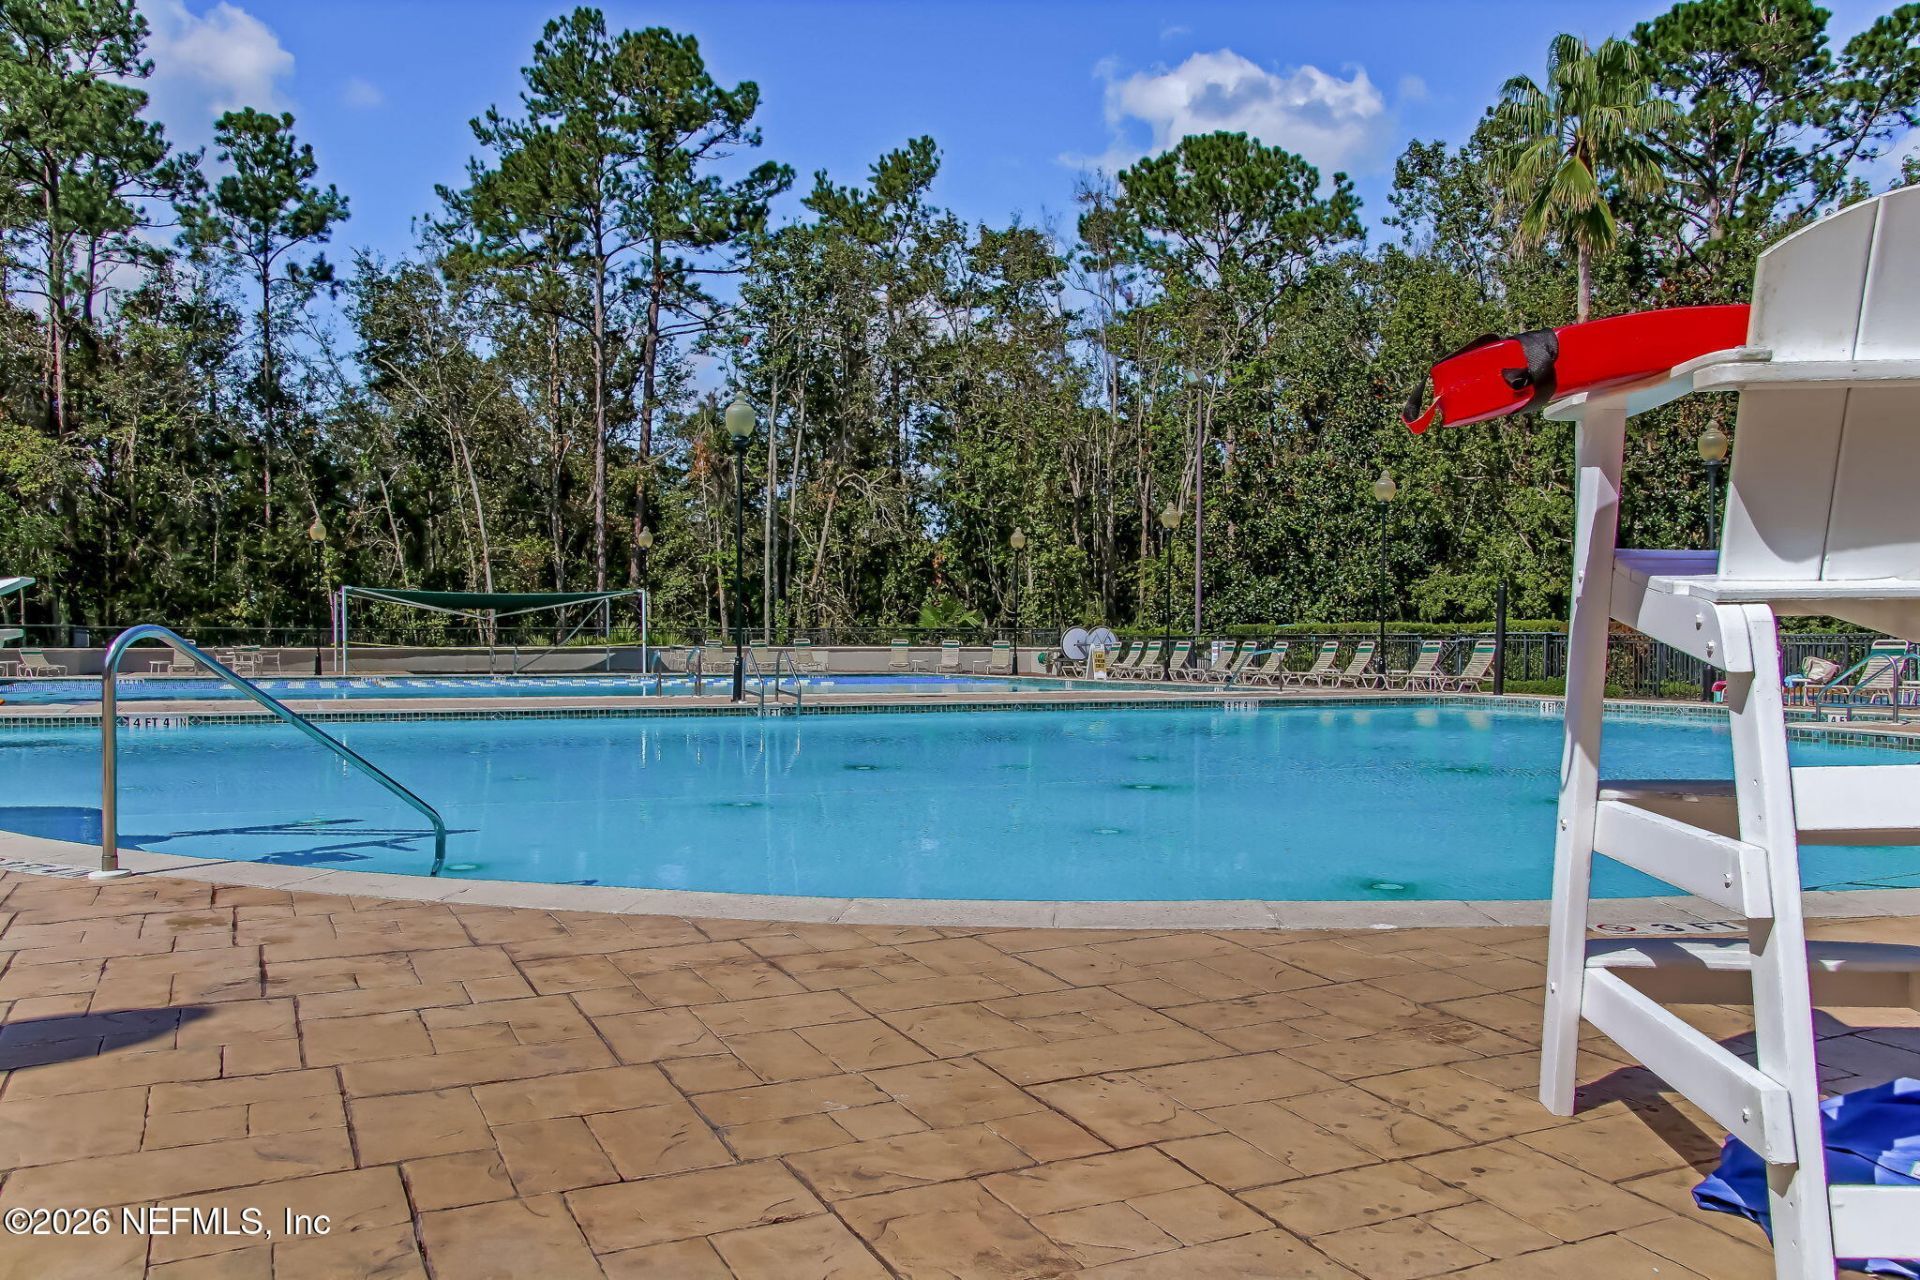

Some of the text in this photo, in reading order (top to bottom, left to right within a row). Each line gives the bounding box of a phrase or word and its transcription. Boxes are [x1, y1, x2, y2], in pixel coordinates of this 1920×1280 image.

[133, 717, 187, 728] 4 FT 4 IN
[1650, 921, 1740, 932] 3 FT
